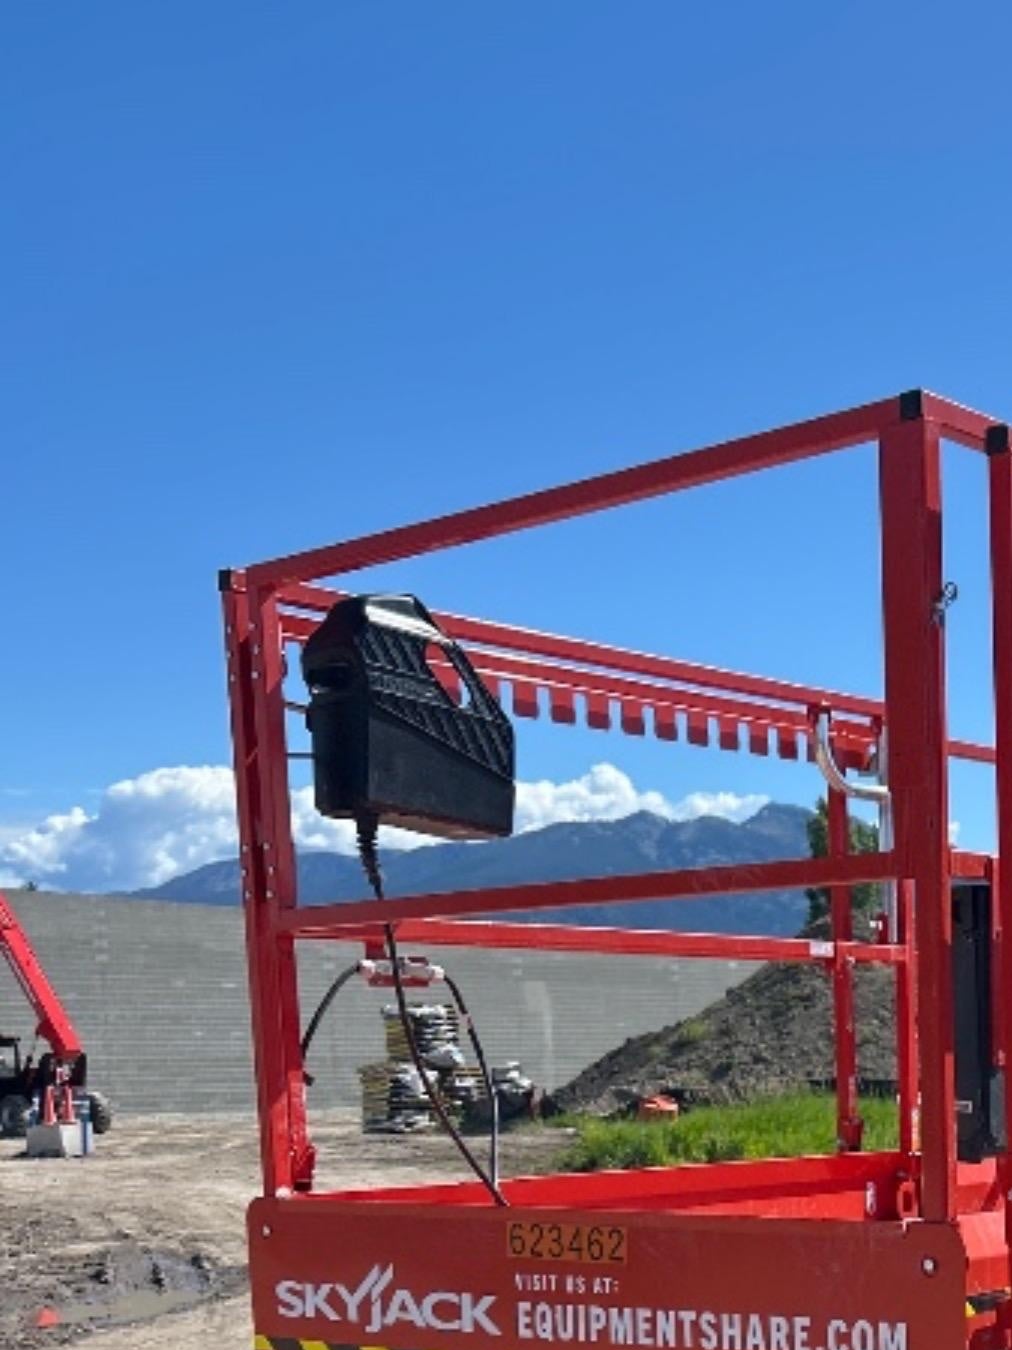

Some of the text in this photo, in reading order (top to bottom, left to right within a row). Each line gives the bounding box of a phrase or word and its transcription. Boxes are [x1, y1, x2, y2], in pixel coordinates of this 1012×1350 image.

[510, 1223, 625, 1262] 623462
[275, 1263, 501, 1334] SKYJACK
[515, 1272, 620, 1295] VISIT US AT:
